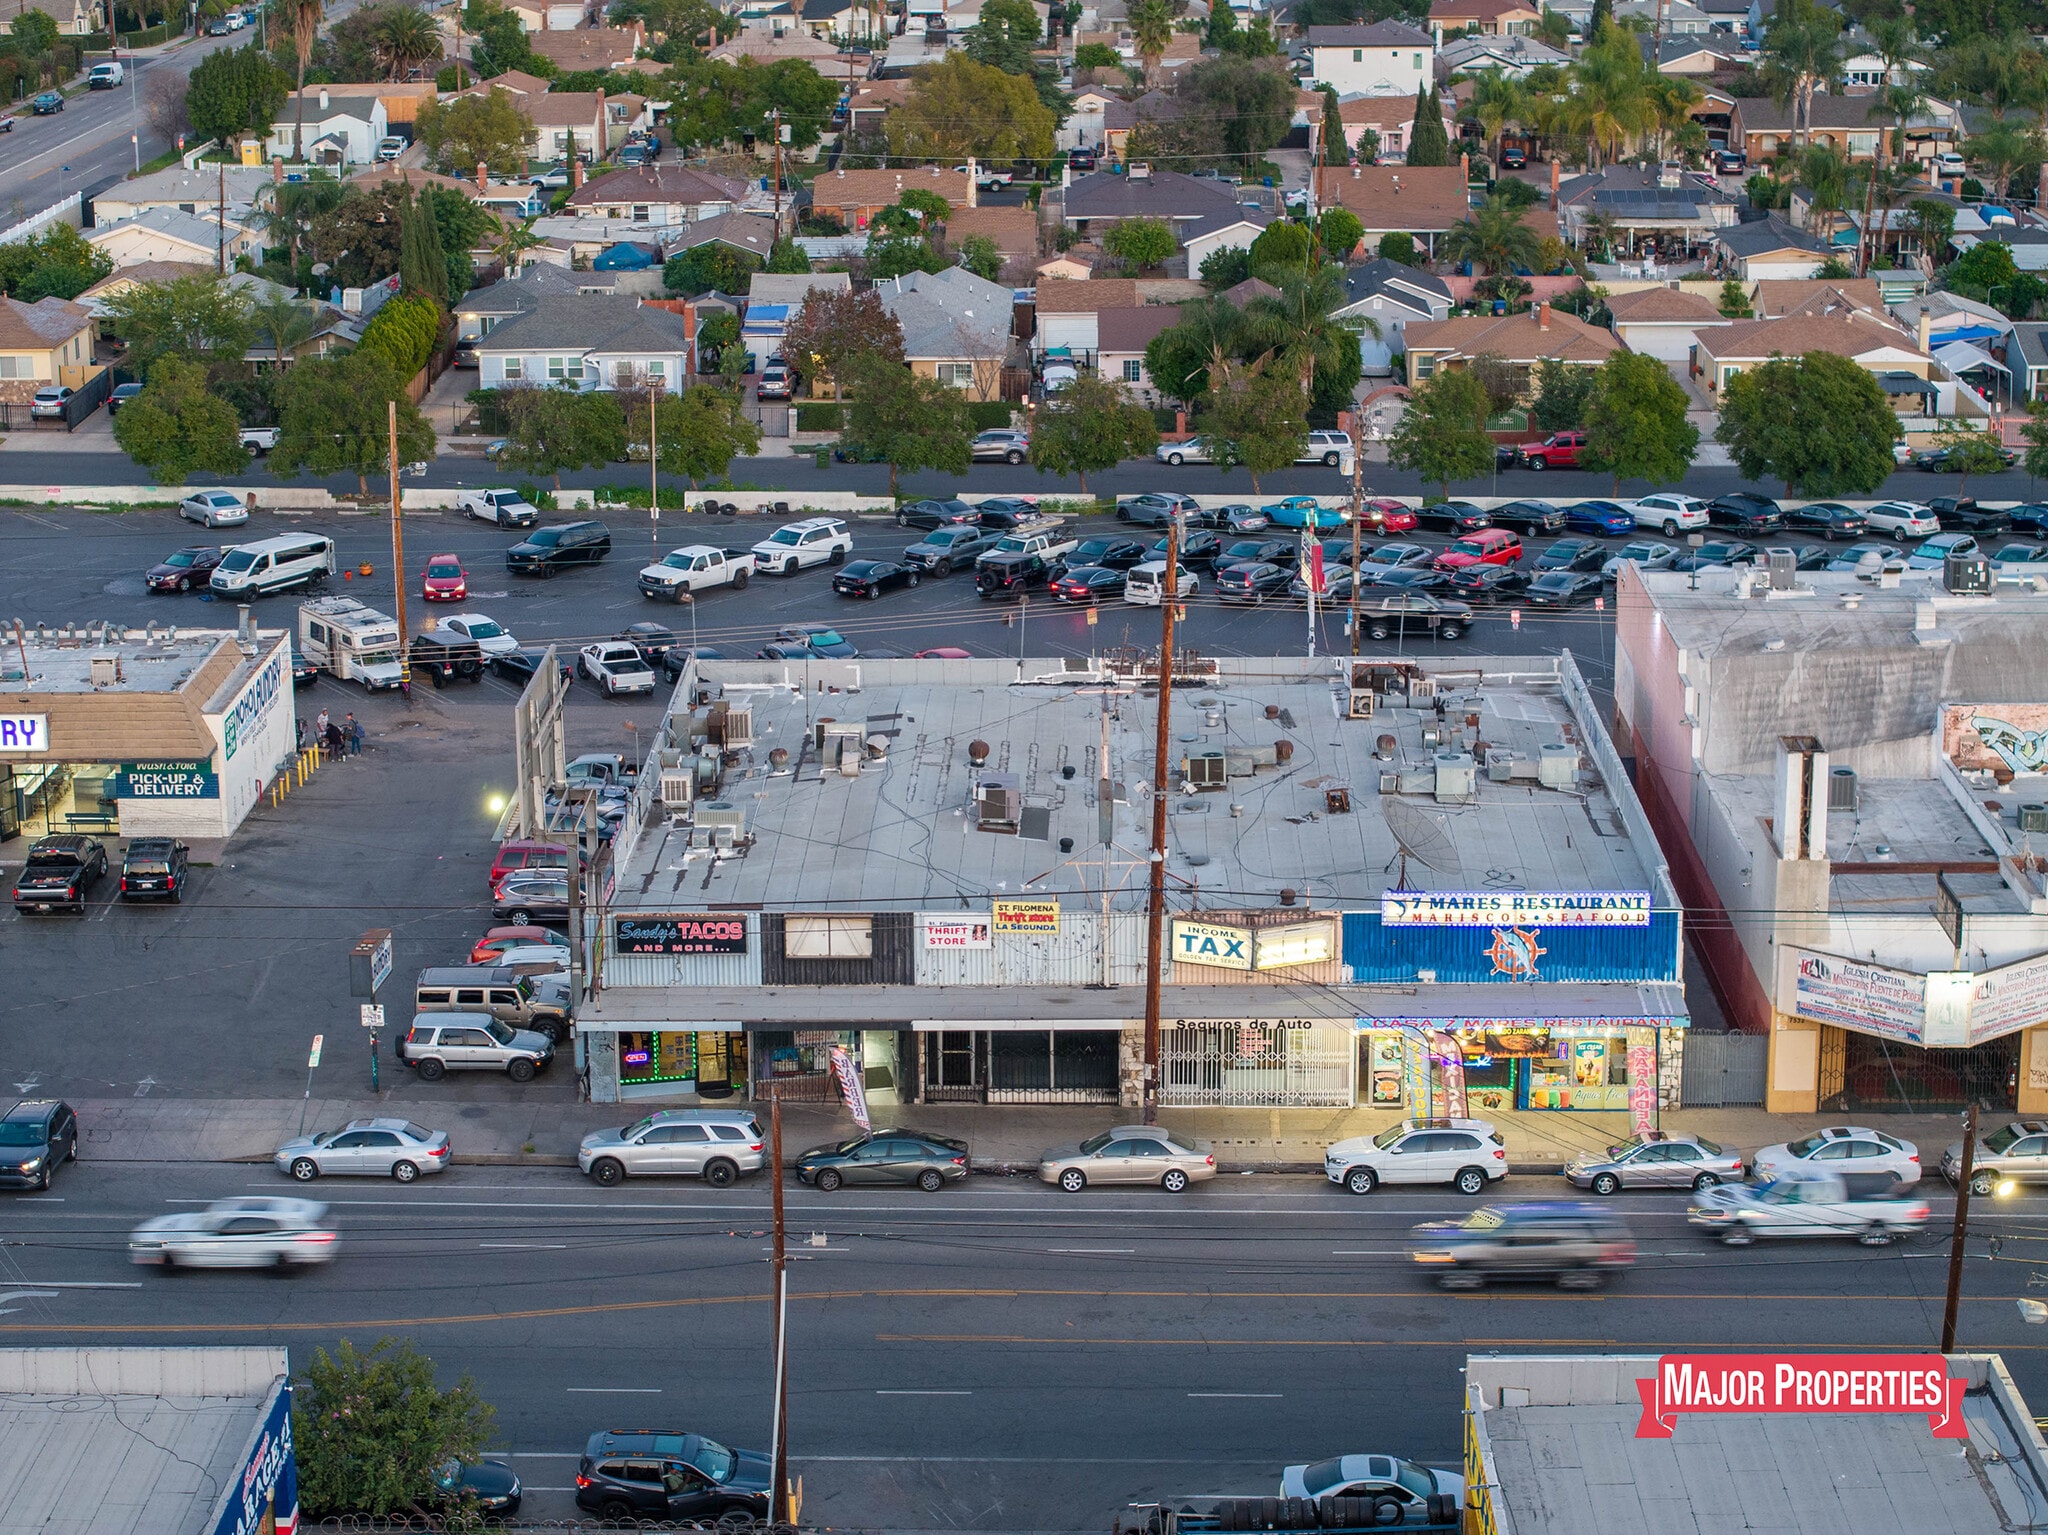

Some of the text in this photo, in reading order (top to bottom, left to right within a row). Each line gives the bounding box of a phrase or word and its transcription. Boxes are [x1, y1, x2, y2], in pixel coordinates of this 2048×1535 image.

[1, 720, 36, 746] RY
[129, 773, 205, 784] PICK-UP &
[134, 784, 203, 795] DELIVERY
[1013, 904, 1054, 912] FILOMENA
[1412, 897, 1645, 910] 7 MARES RESTAURANT
[998, 912, 1027, 924] Thrift
[1412, 912, 1645, 923] MARISCOS SEAFOOD
[620, 921, 743, 943] Sandy's TACOS
[928, 927, 968, 935] THRIFT
[1011, 923, 1056, 931] SEGUNDA
[1188, 926, 1238, 938] INCOME
[633, 944, 664, 952] AND
[1179, 934, 1245, 959] TAX
[1843, 965, 1869, 980] IGLESIA
[1176, 1019, 1312, 1032] Seguros de Auto
[1373, 1019, 1432, 1028] CASA
[1446, 1019, 1457, 1027] 7
[1544, 1018, 1672, 1027] RESTAURANT
